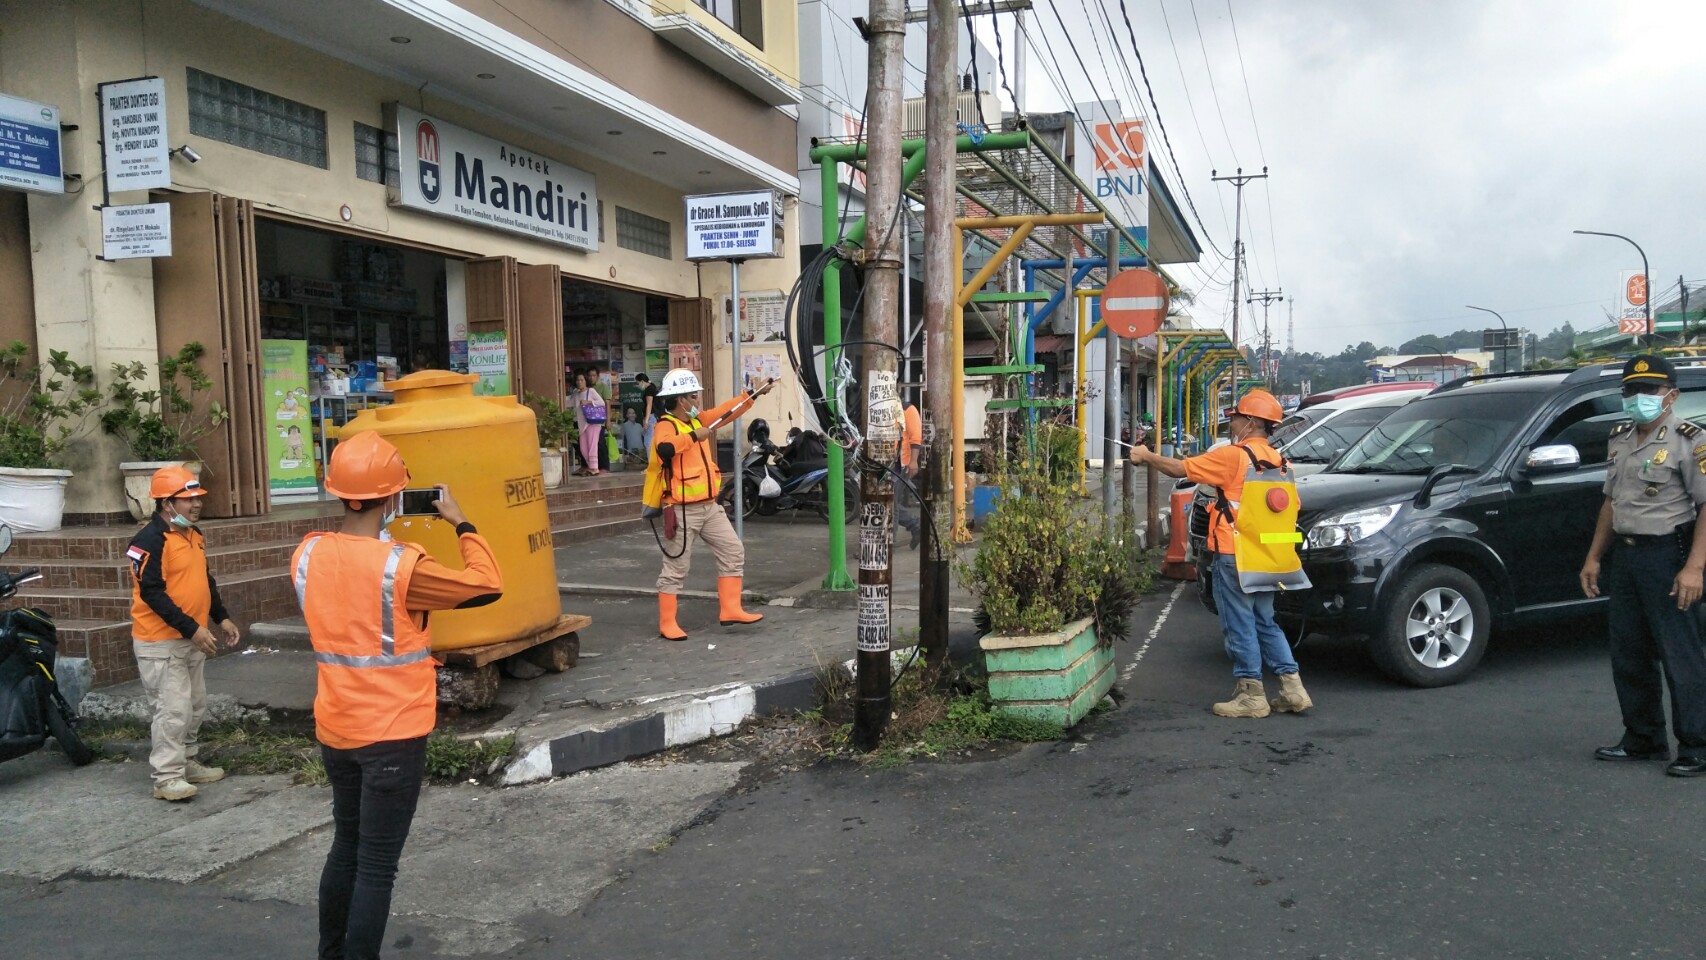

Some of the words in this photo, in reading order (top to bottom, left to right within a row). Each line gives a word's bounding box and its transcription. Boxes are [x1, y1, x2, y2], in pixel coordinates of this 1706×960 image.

[130, 93, 148, 108] DOKTER
[149, 92, 159, 106] GIGI
[121, 128, 137, 138] NOVITA
[124, 140, 142, 151] HENDRY
[500, 146, 549, 175] Apotek
[455, 151, 588, 232] Mandiri
[1097, 174, 1143, 197] BNI
[461, 205, 472, 216] Raya
[472, 208, 493, 221] Tomohon,
[698, 206, 714, 220] Grace
[700, 232, 723, 240] PRAKTEK
[724, 231, 738, 239] SENIN
[743, 230, 759, 238] JUMAT
[704, 241, 719, 249] PUKUL
[736, 239, 756, 248] SELESAI
[876, 586, 888, 598] WC
